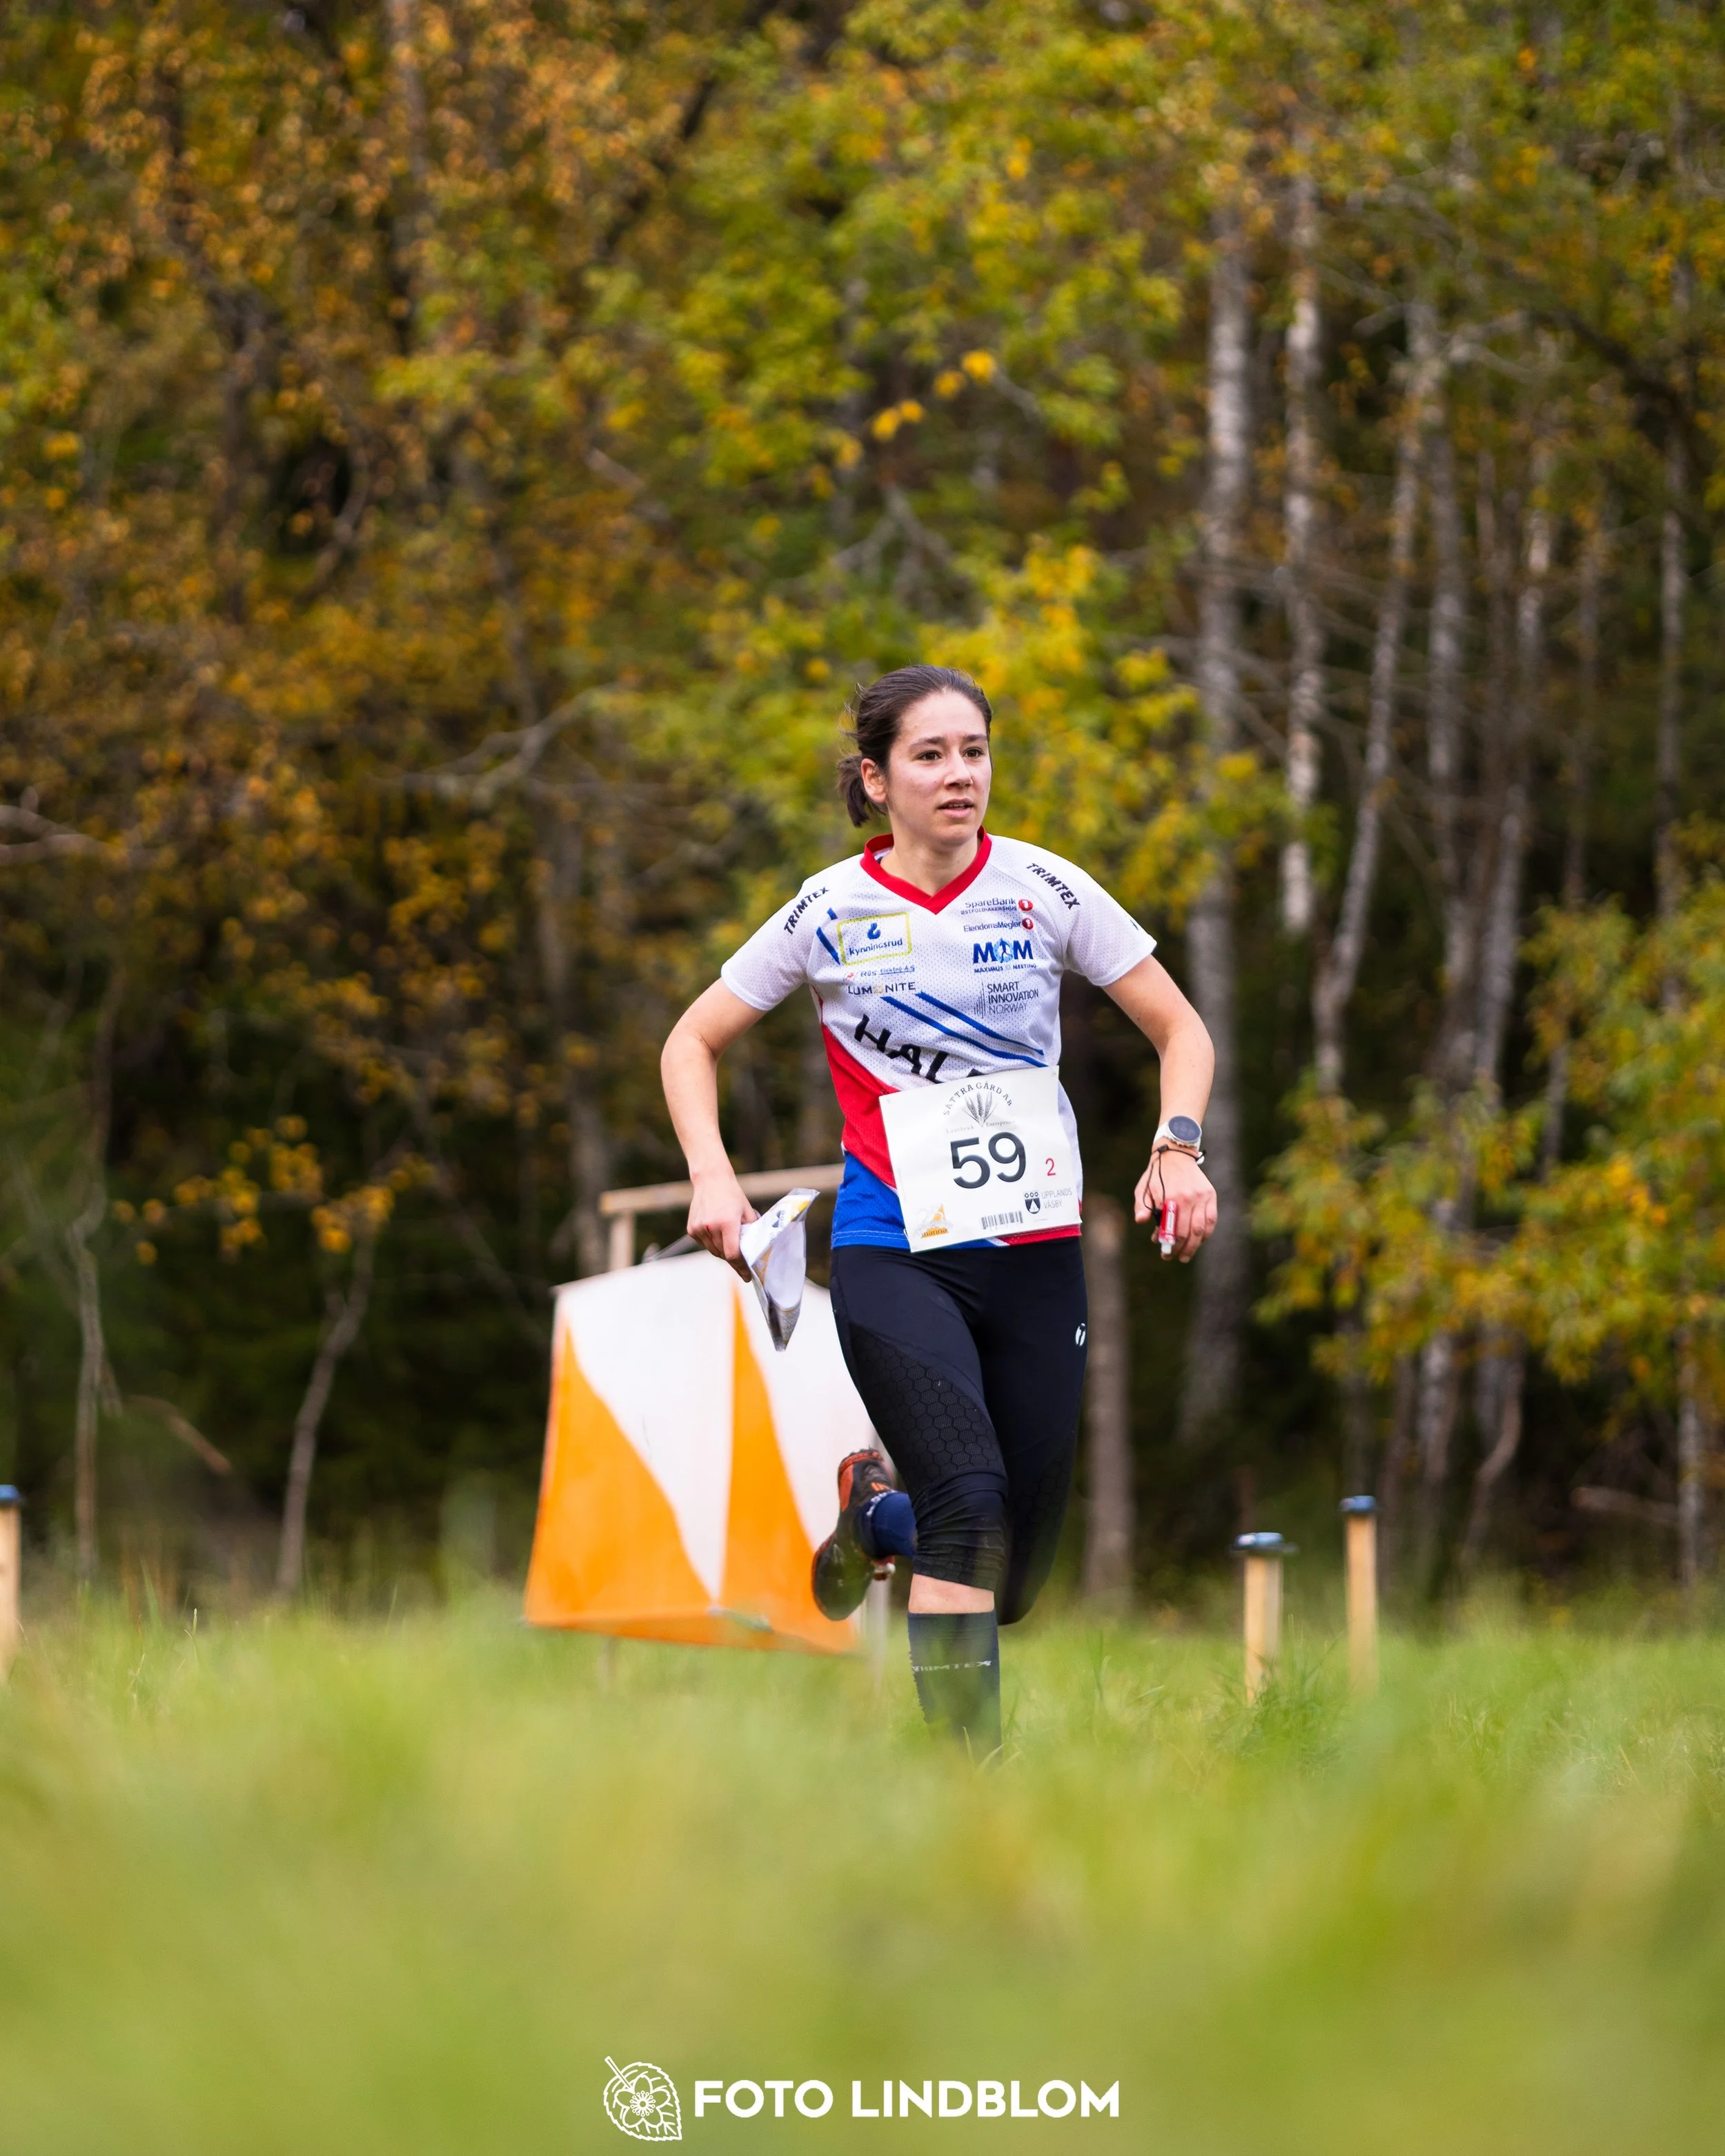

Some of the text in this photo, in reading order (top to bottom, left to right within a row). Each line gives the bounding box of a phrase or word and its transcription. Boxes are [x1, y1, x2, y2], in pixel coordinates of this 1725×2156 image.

[1026, 862, 1081, 910] TRIMTEX
[783, 887, 829, 935] TRIMTEX
[965, 898, 1016, 909] SpareBank
[849, 938, 903, 956] kynningsrud
[974, 965, 1003, 973] MAXIMUS
[987, 981, 1019, 993] SMART
[988, 989, 1038, 1005] INNOVATION
[989, 1001, 1027, 1014] NORWAY
[854, 1013, 985, 1084] HAL
[949, 1131, 1026, 1189] 59
[1045, 1158, 1056, 1176] 2
[1041, 1187, 1072, 1199] UPPLANDS
